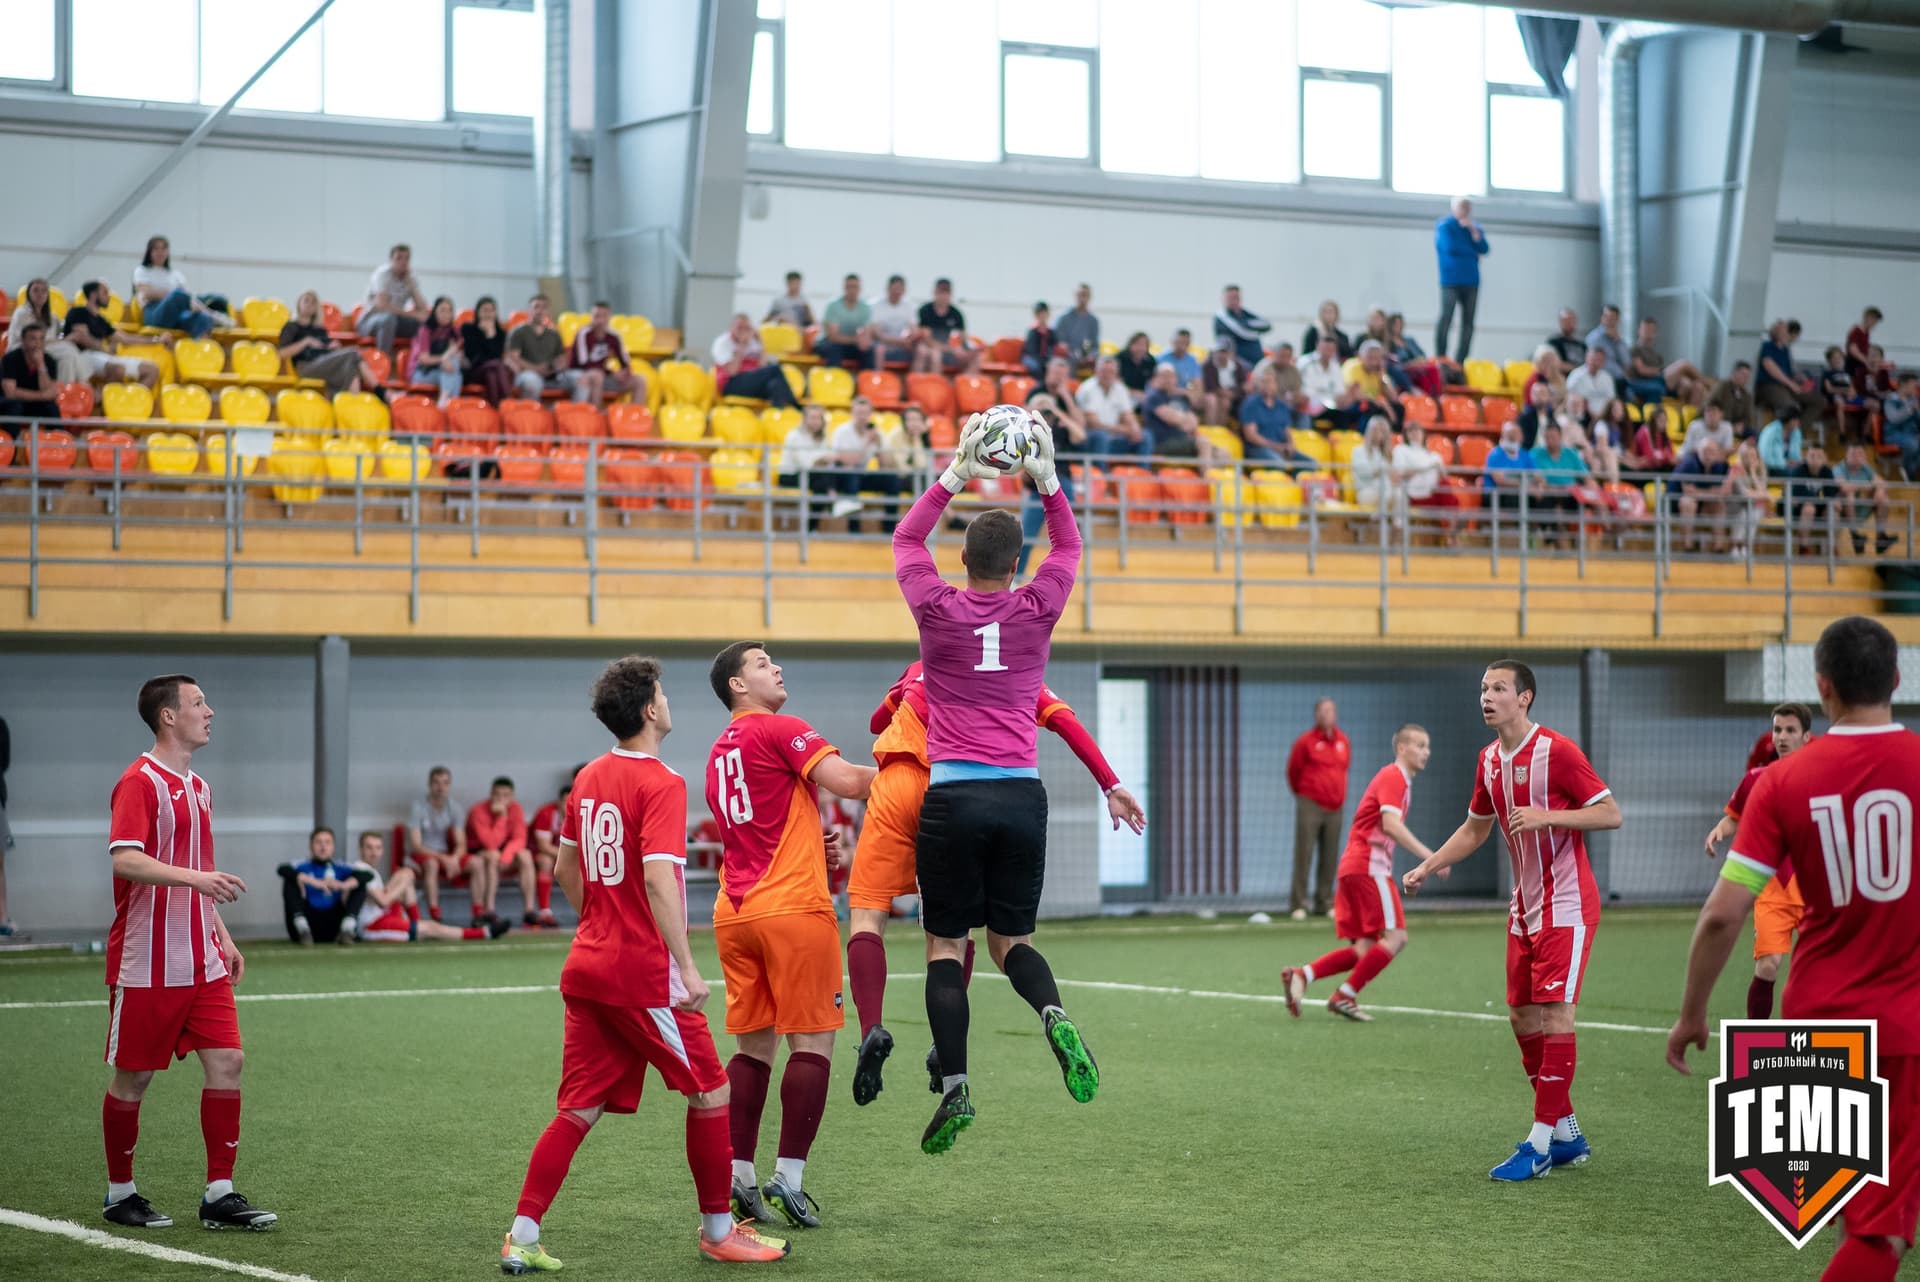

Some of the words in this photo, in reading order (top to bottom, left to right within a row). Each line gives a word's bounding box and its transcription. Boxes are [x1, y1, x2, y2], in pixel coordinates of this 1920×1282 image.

[973, 621, 1009, 671] 1
[714, 747, 753, 829] 13
[580, 798, 625, 886] 18
[1809, 788, 1913, 907] 10
